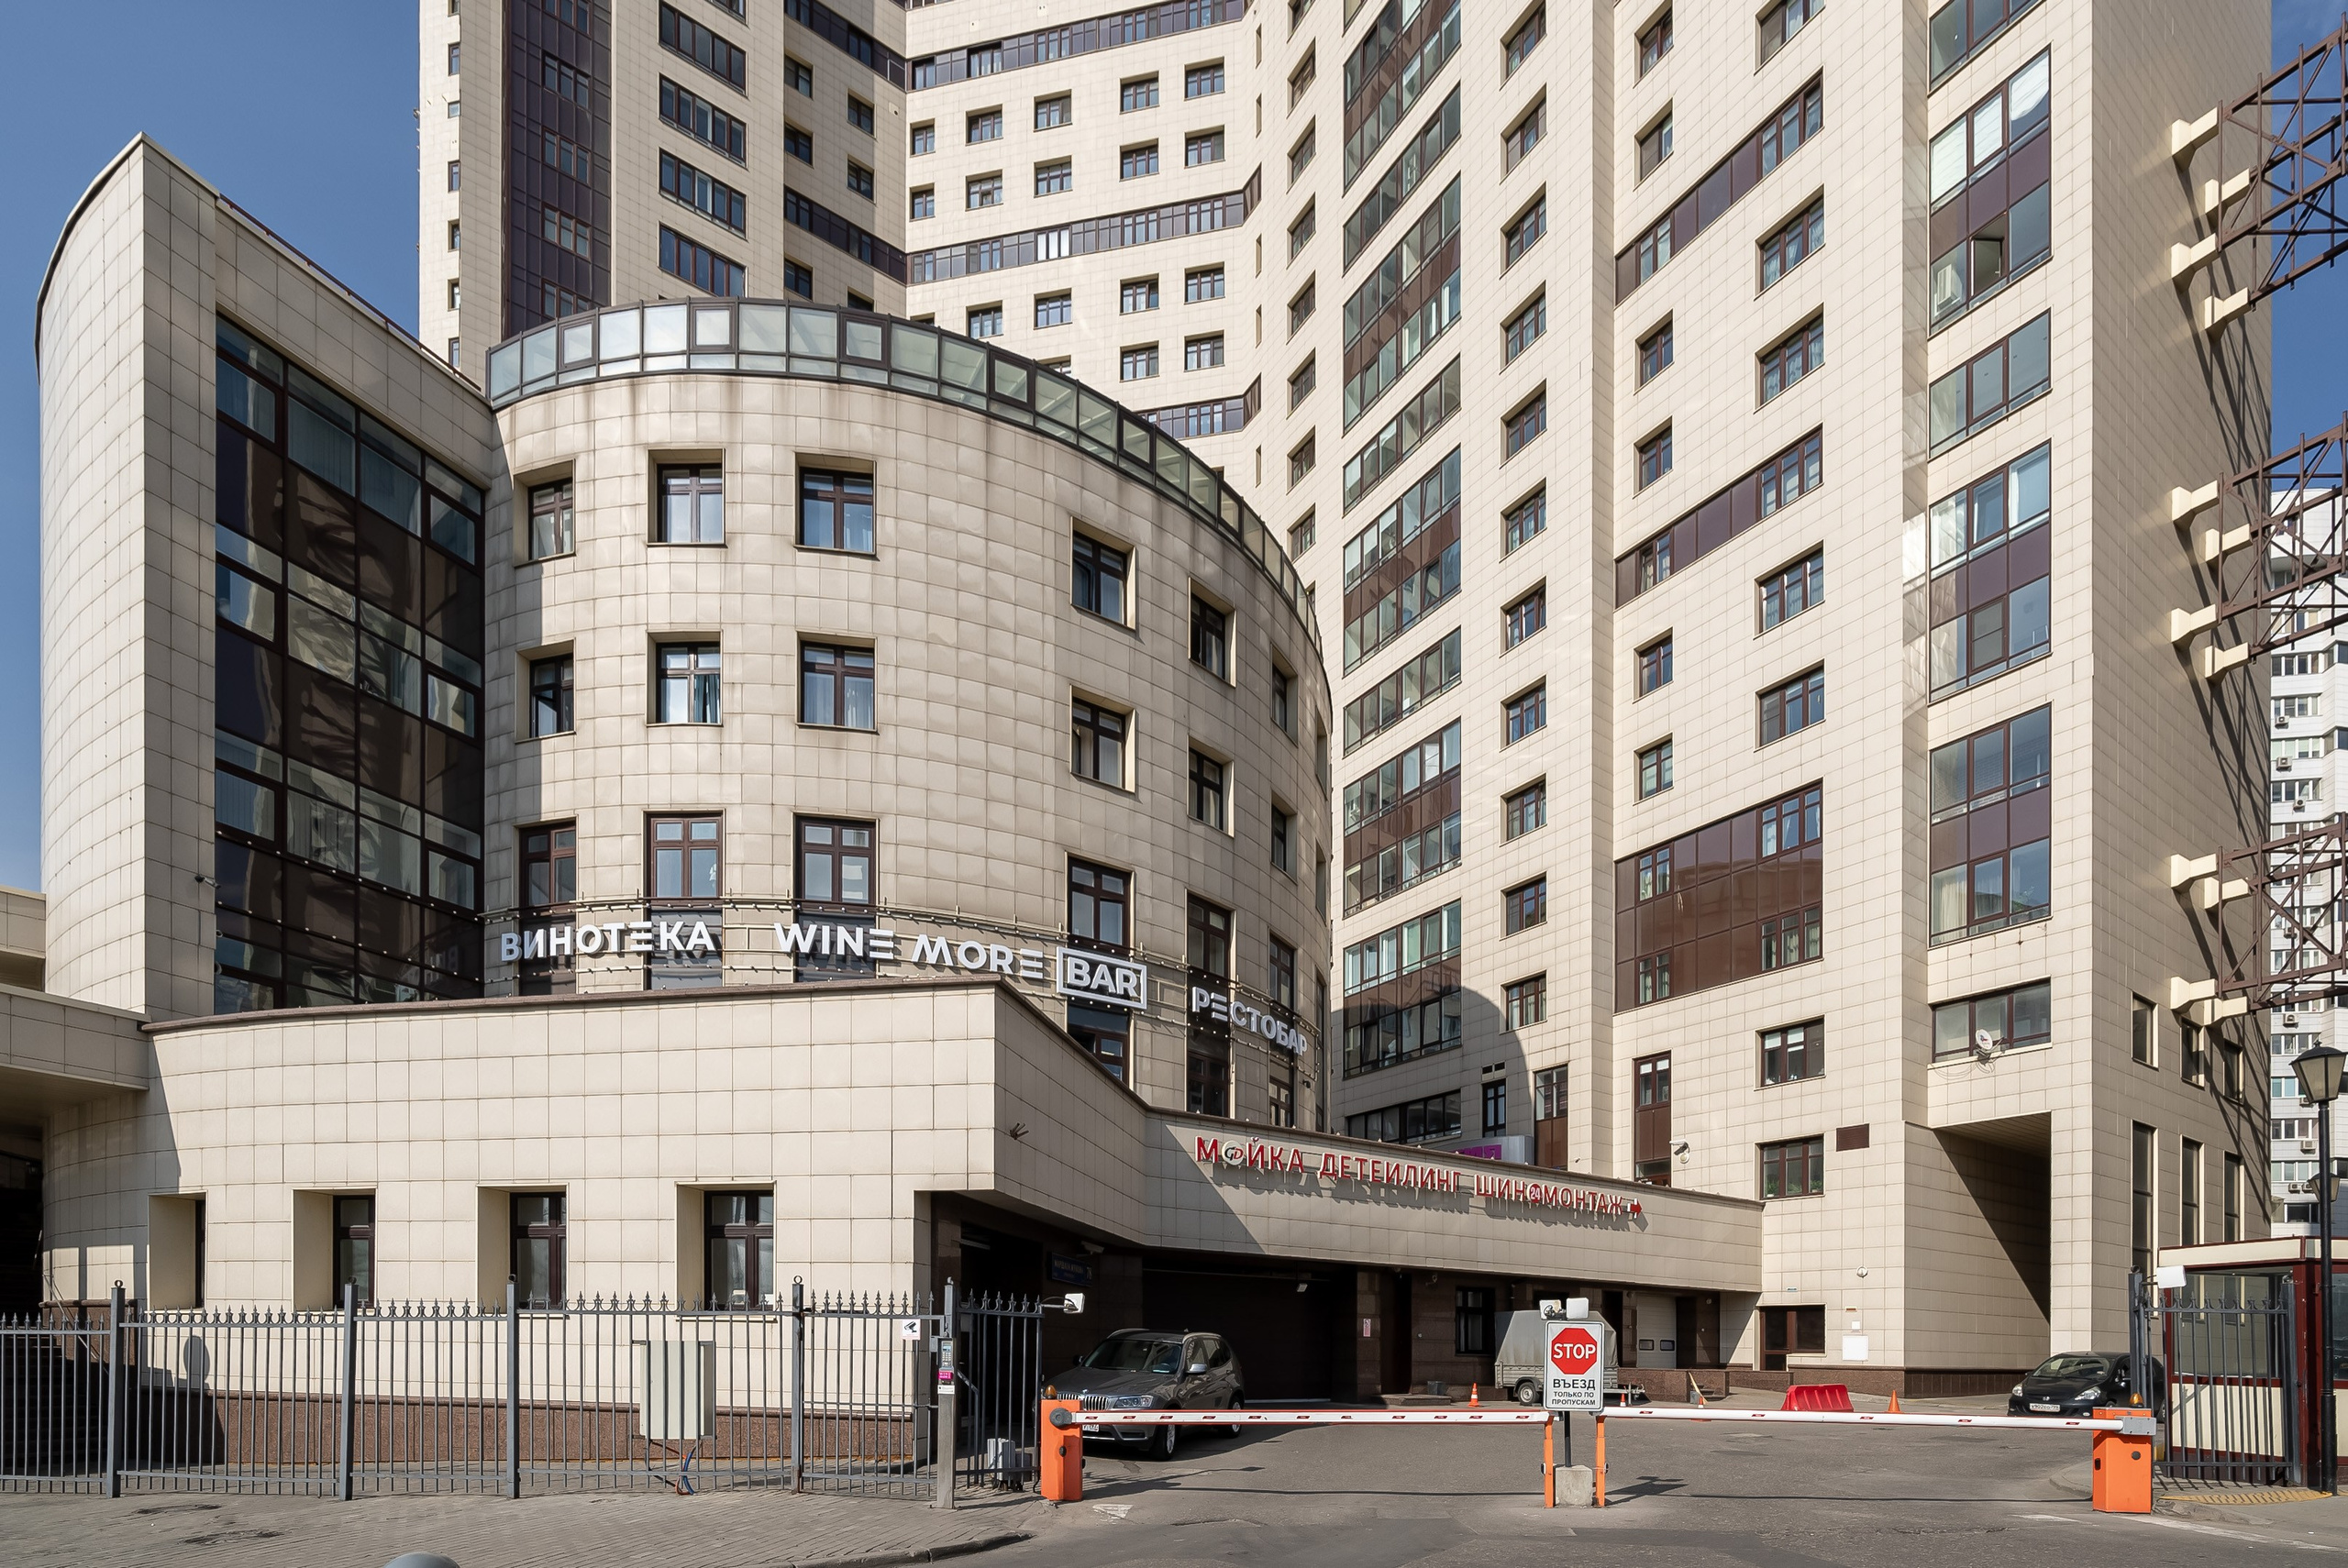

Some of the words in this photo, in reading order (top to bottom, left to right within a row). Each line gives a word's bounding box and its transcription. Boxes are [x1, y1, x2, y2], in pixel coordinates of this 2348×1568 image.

[501, 921, 715, 963] ВИНОТЕКА
[774, 922, 894, 959] WINE
[912, 934, 1043, 978] MORE
[1068, 956, 1140, 997] BAR
[1192, 987, 1307, 1055] РЕСТОБАР
[1553, 1343, 1596, 1359] STOP
[1553, 1378, 1595, 1390] ВЪЕЗД
